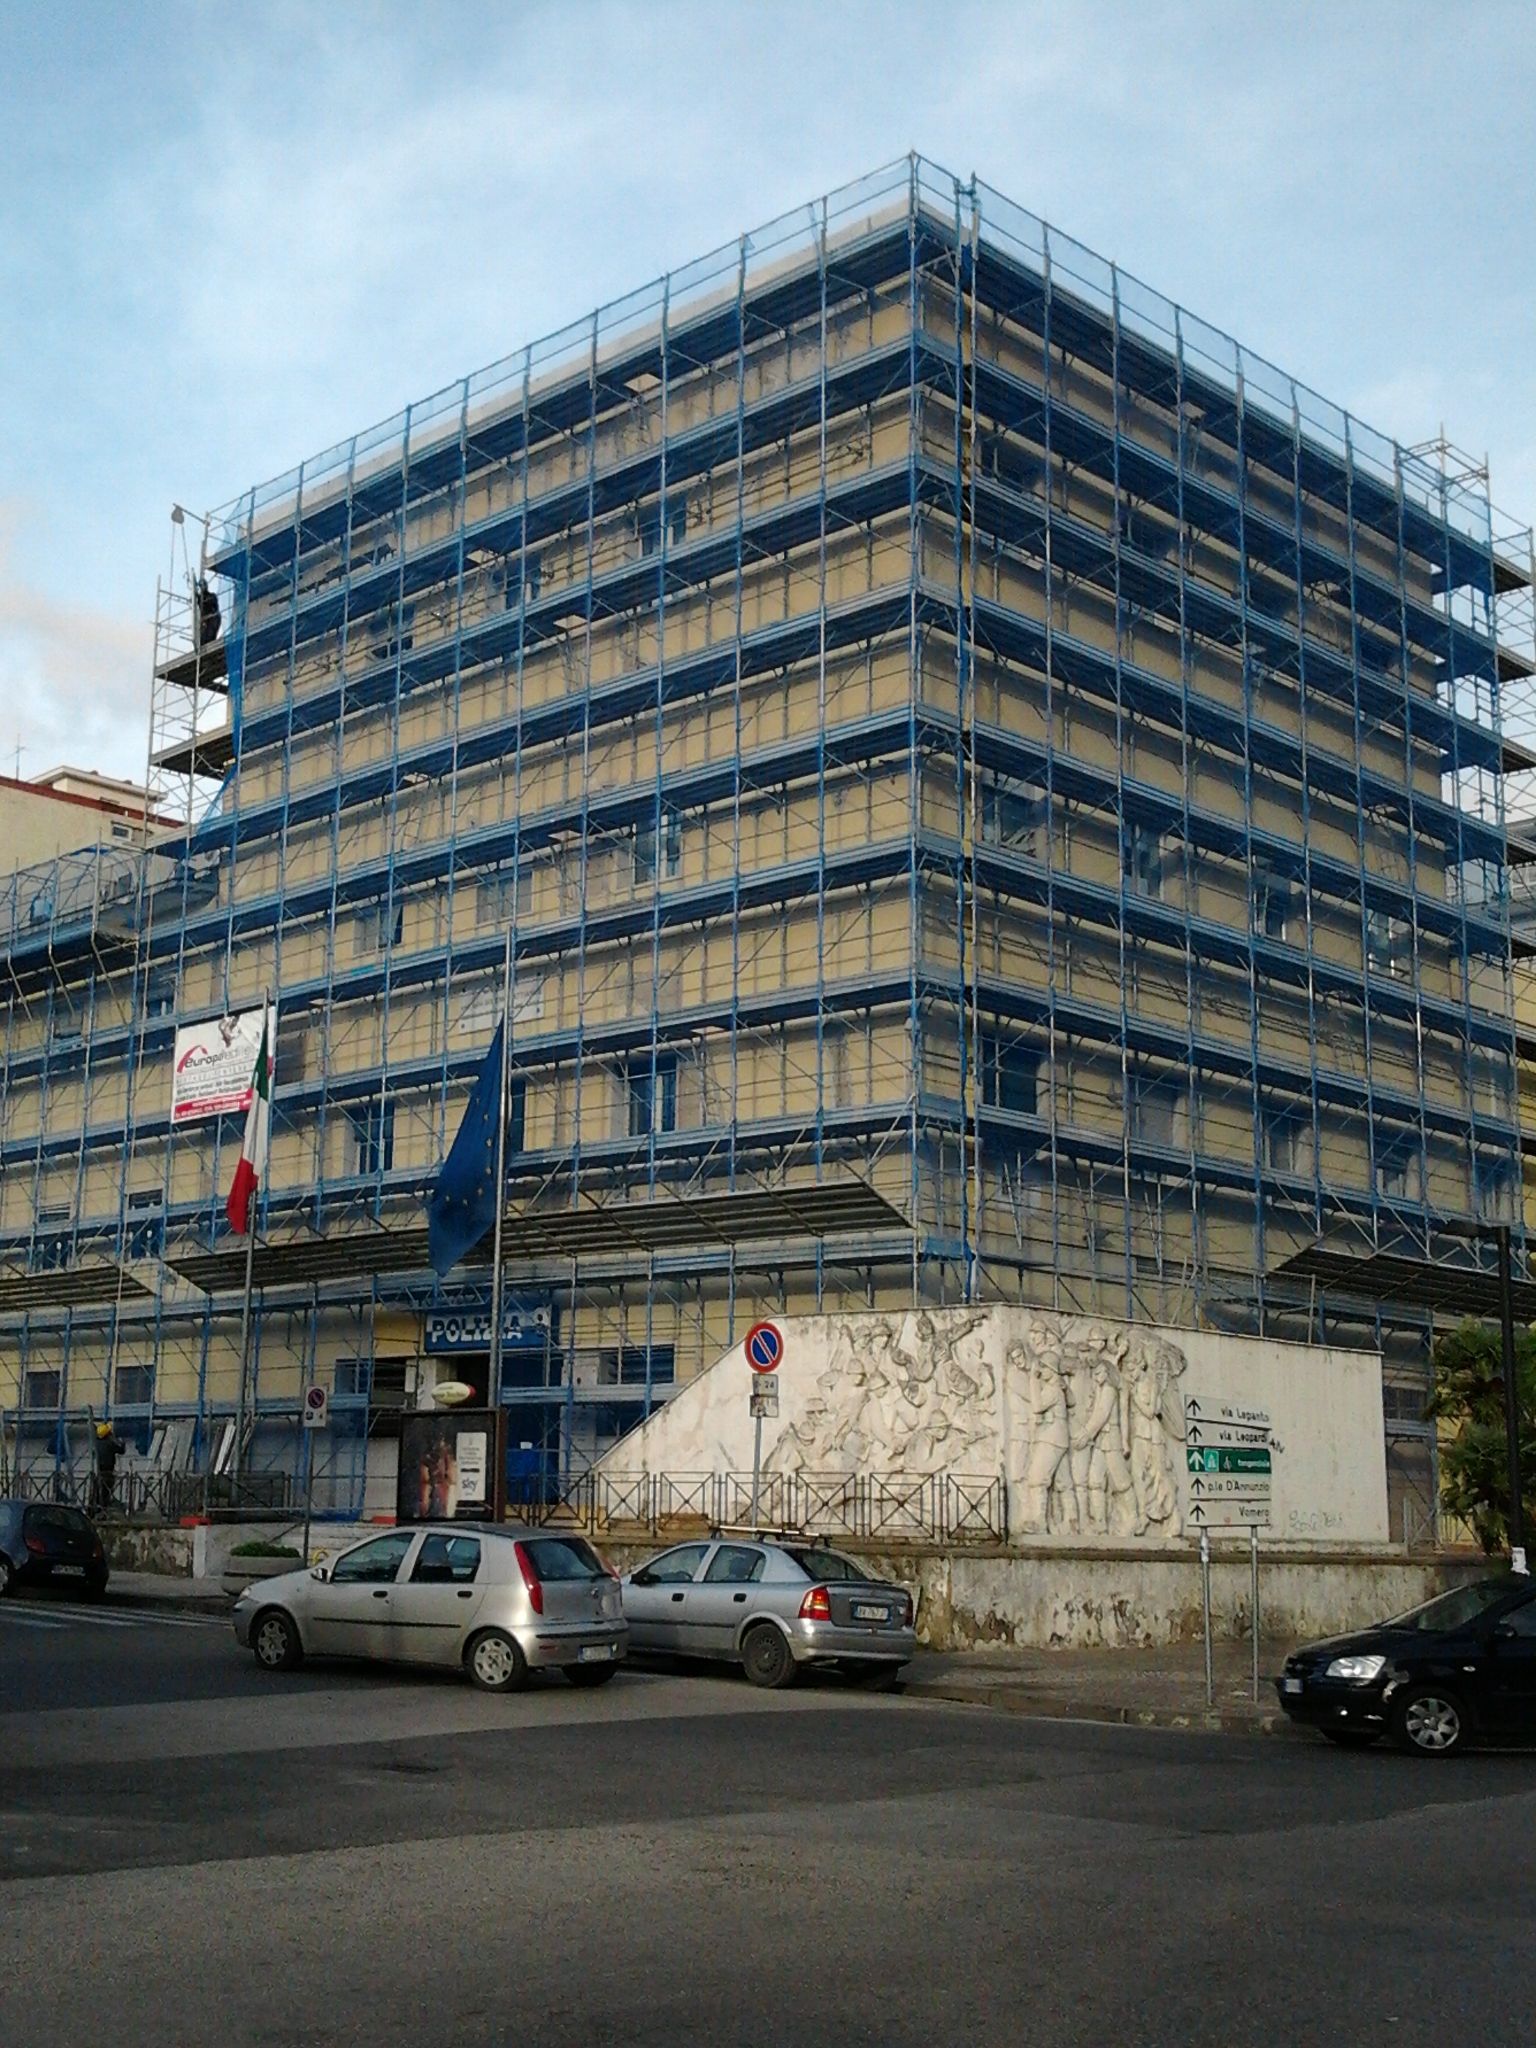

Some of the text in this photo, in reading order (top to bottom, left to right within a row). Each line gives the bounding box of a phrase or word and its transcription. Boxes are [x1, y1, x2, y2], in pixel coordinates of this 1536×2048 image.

[1220, 1406, 1270, 1423] via Lepanto
[1219, 1430, 1232, 1442] via
[1238, 1506, 1270, 1517] Vomero
